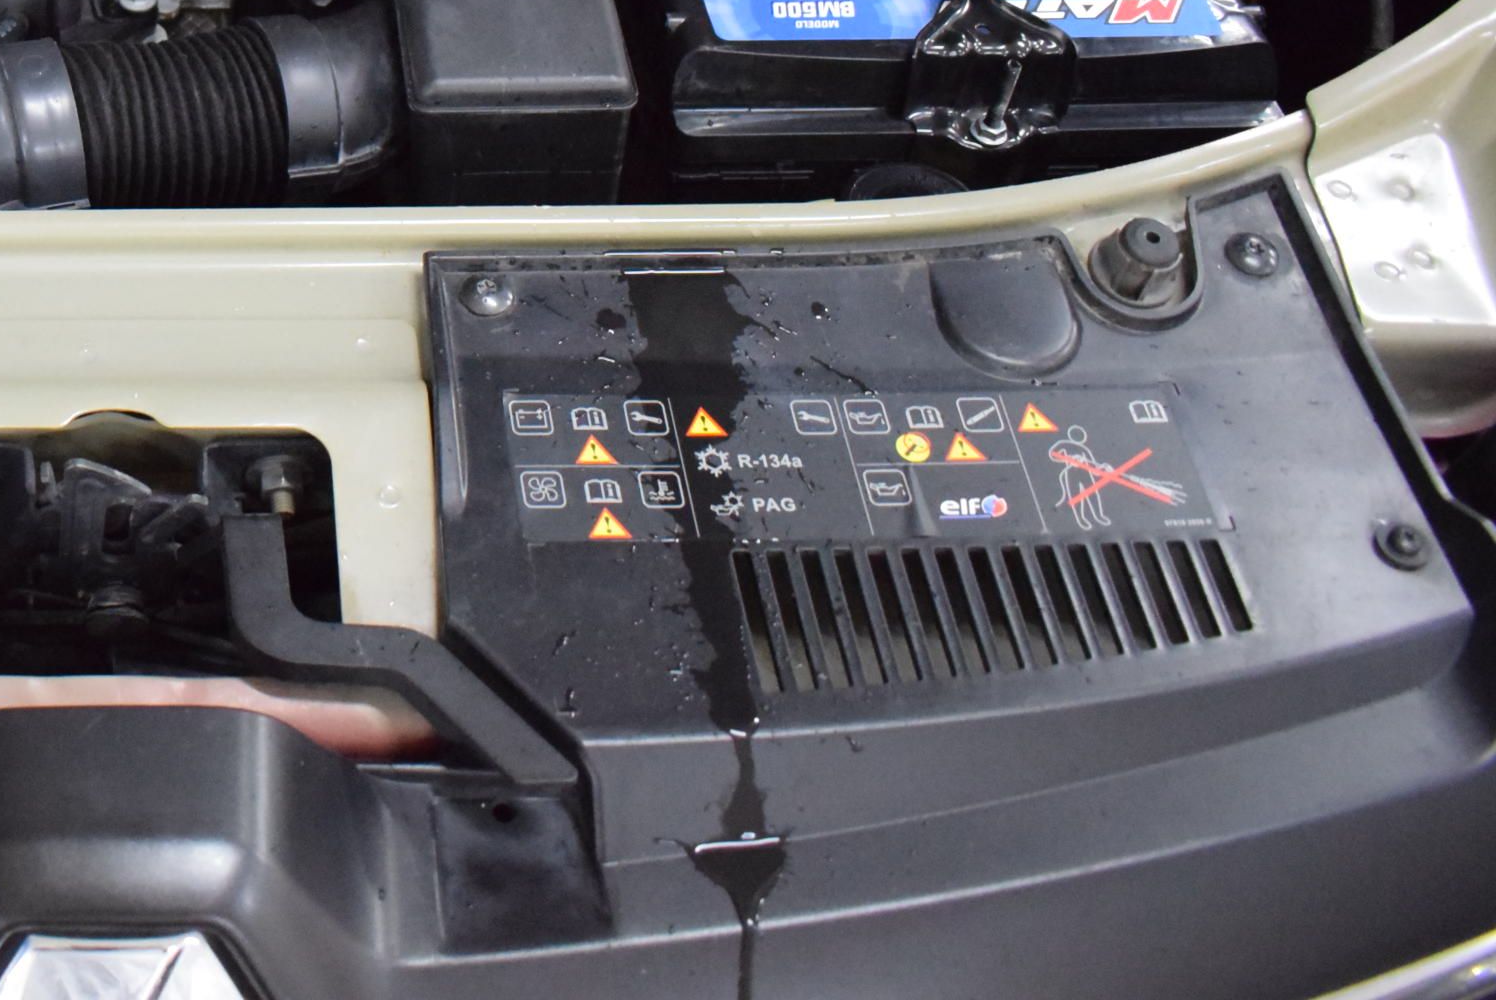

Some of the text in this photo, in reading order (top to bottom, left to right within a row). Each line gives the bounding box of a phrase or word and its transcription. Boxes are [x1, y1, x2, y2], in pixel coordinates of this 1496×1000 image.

[795, 19, 840, 29] MODELO
[737, 453, 803, 469] R-134a
[751, 497, 797, 512] PAG
[940, 497, 981, 516] elf
